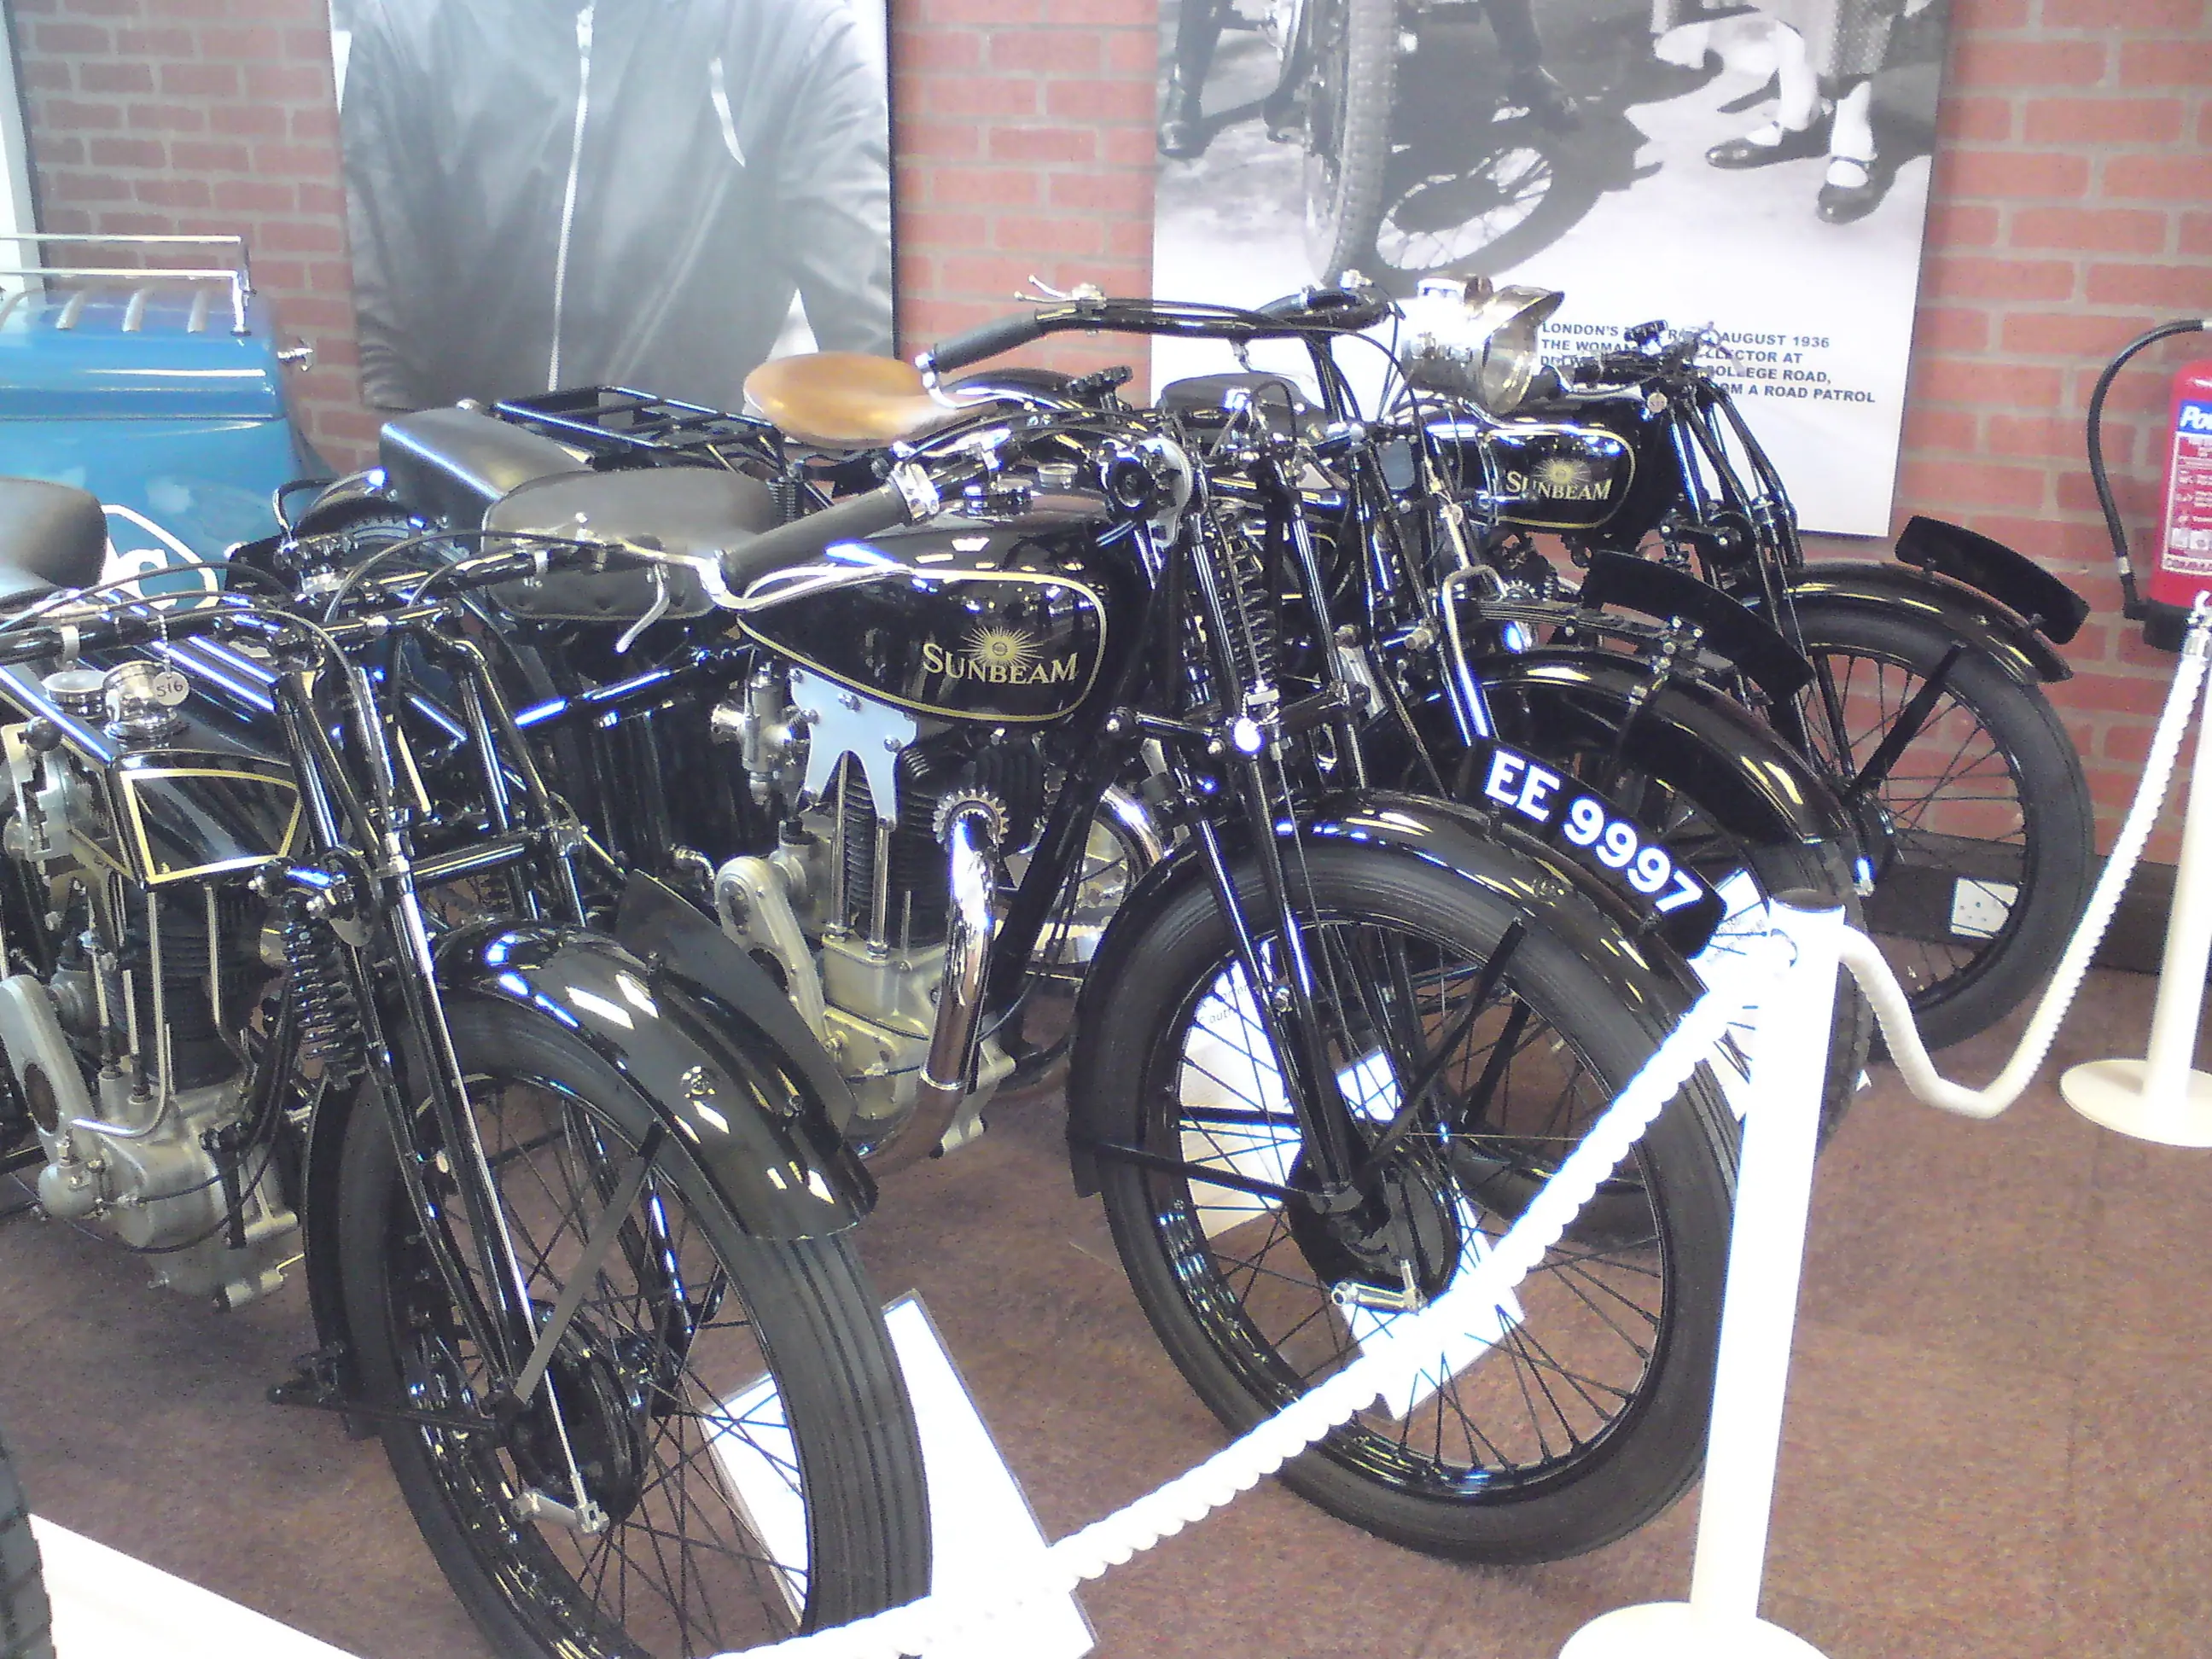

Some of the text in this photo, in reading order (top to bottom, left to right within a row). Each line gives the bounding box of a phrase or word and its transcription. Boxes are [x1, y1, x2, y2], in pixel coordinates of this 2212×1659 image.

[1542, 322, 1619, 336] LONDON'S
[1721, 332, 1786, 346] AUGUST
[1793, 336, 1830, 348] 1936
[1541, 339, 1570, 350] THE
[1784, 352, 1803, 364] AT
[1784, 370, 1831, 385] ROAD,
[1749, 385, 1758, 395] A
[1765, 386, 1808, 399] ROAD
[1813, 389, 1876, 403] PATROL
[923, 643, 1079, 684] SUNBEAM
[1484, 749, 1704, 913] EE 9997
